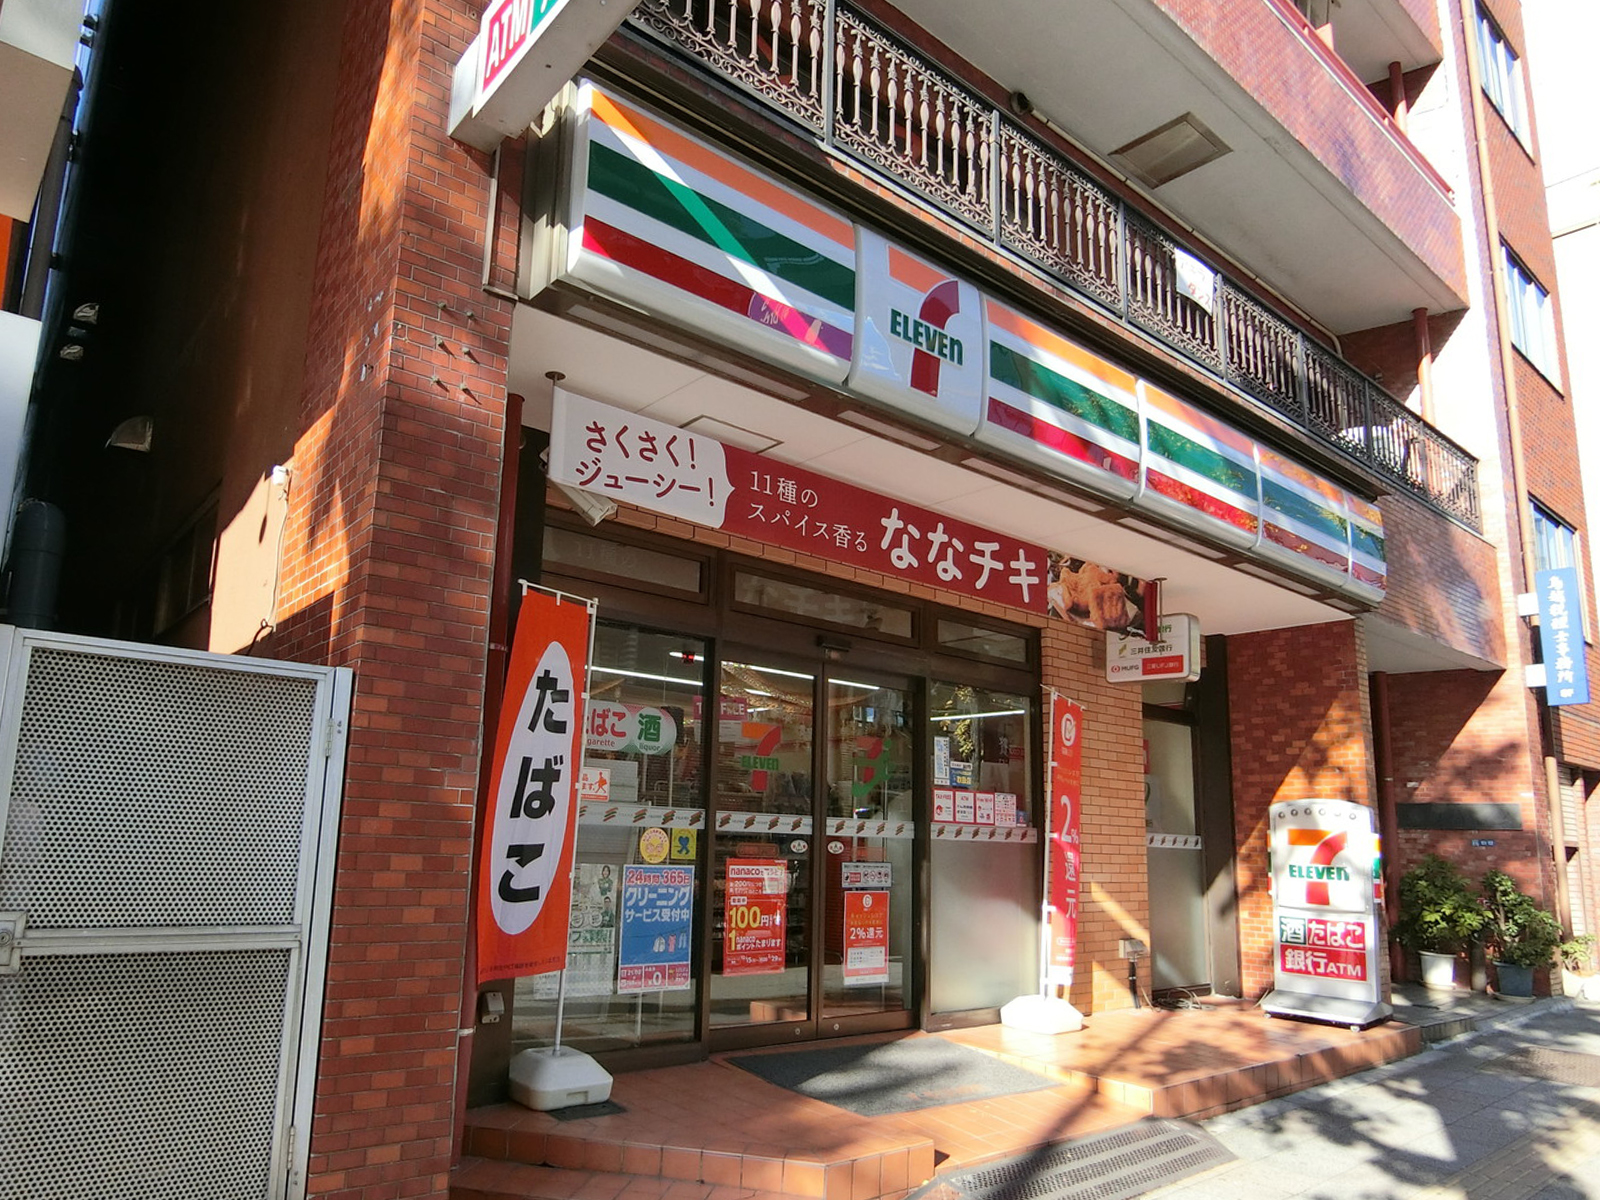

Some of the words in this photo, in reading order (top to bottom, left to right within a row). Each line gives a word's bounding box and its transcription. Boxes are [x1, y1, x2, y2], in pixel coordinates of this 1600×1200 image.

[484, 0, 528, 78] ATM
[750, 470, 819, 510] 11種の
[747, 502, 868, 553] スパイス香る
[880, 507, 1040, 604] ななチキ
[587, 707, 627, 738] ばこ
[637, 712, 662, 743] 酒
[587, 738, 616, 748] garette
[639, 742, 661, 752] liquor
[497, 668, 570, 904] たばこ
[625, 886, 690, 907] クリーニング
[624, 907, 690, 923] サービス受付中
[1281, 918, 1305, 945] 酒
[1308, 920, 1365, 949] たばこ
